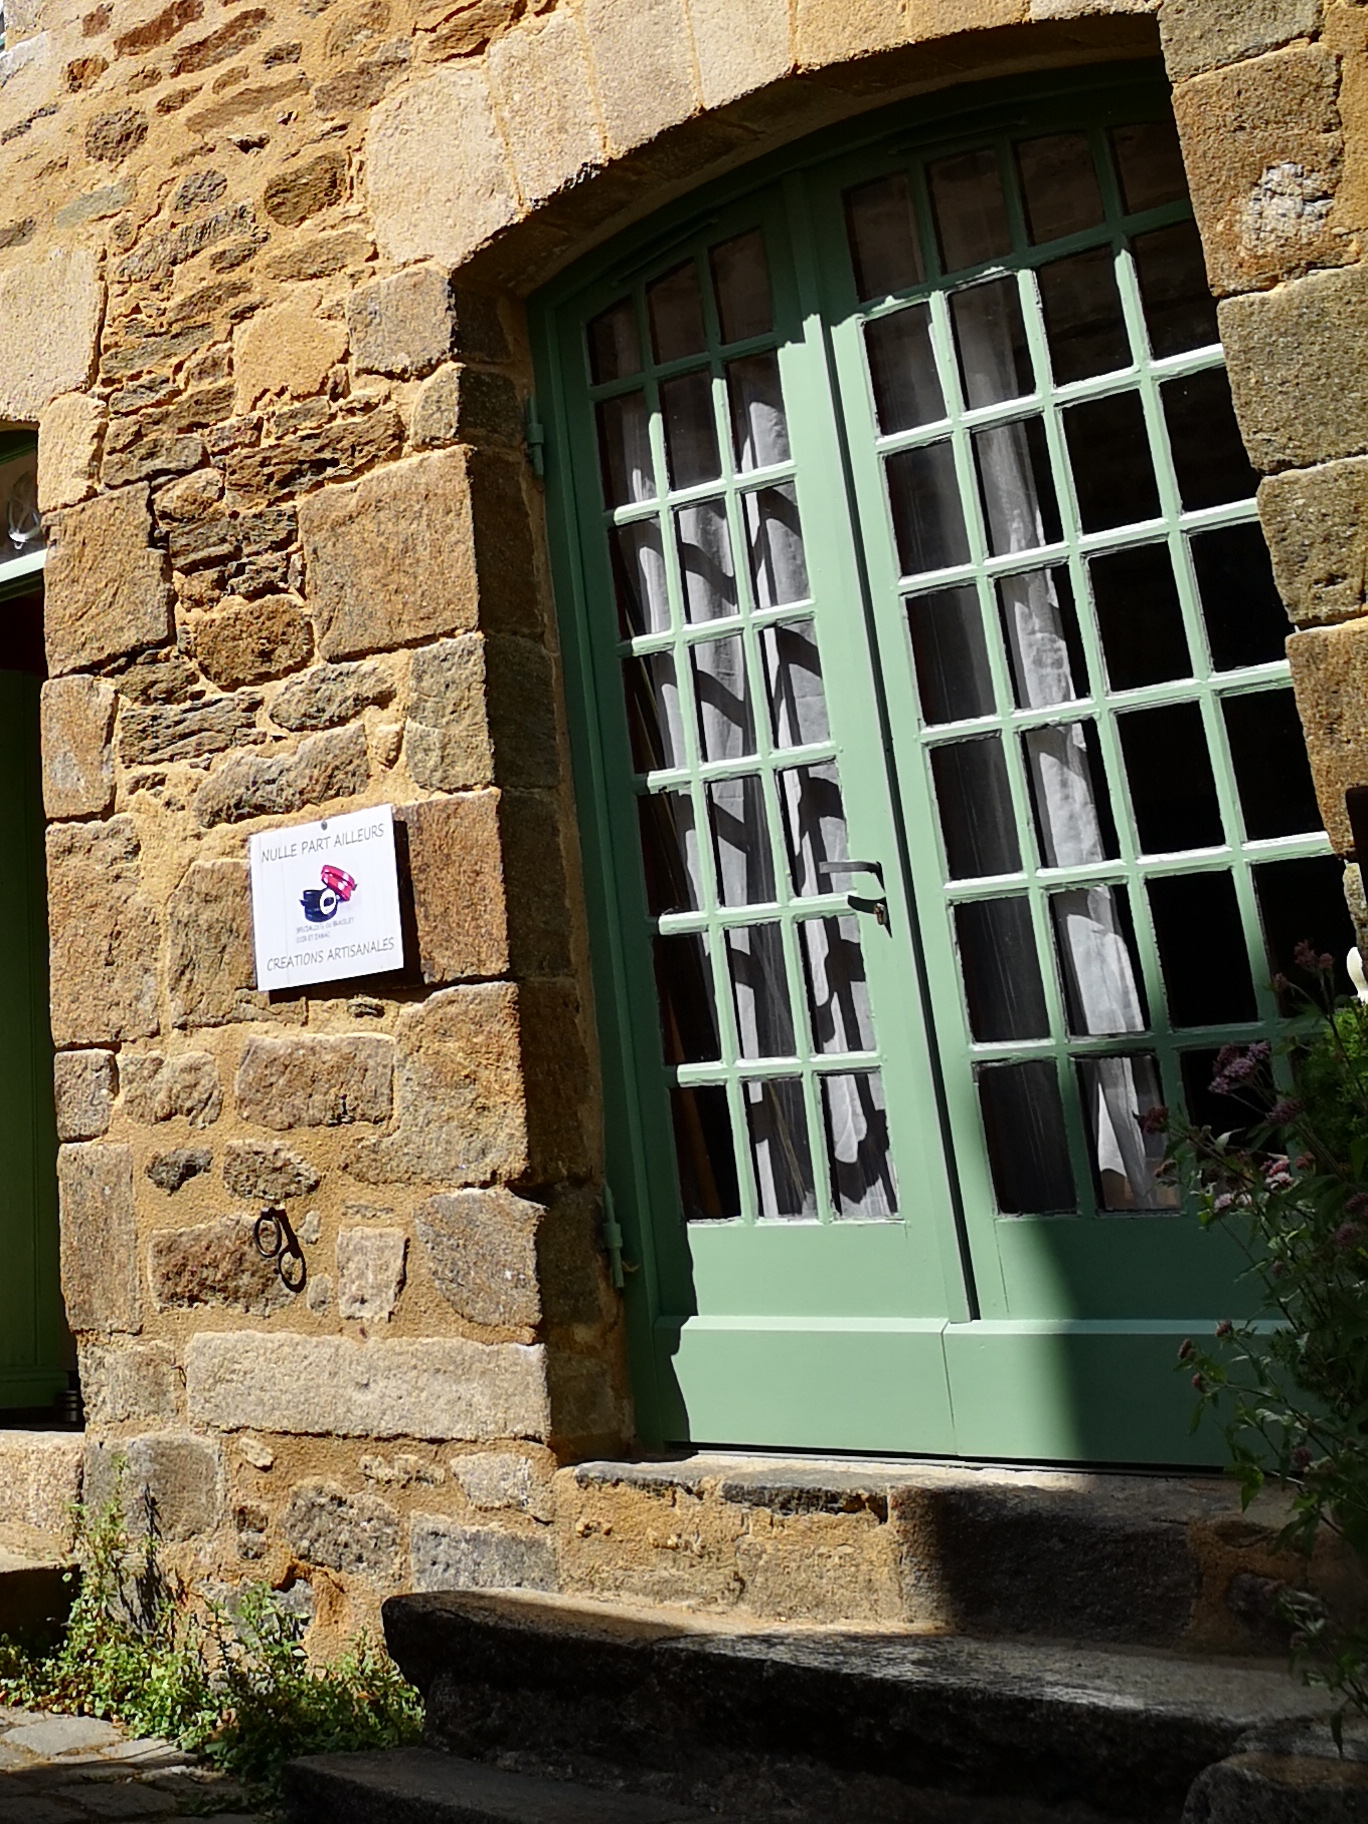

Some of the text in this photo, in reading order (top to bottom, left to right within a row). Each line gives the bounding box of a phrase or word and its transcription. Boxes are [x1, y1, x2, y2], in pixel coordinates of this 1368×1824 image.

[261, 823, 384, 862] NULLE PART AILLEURS
[267, 936, 395, 971] CREATIONS ARTISANALES
